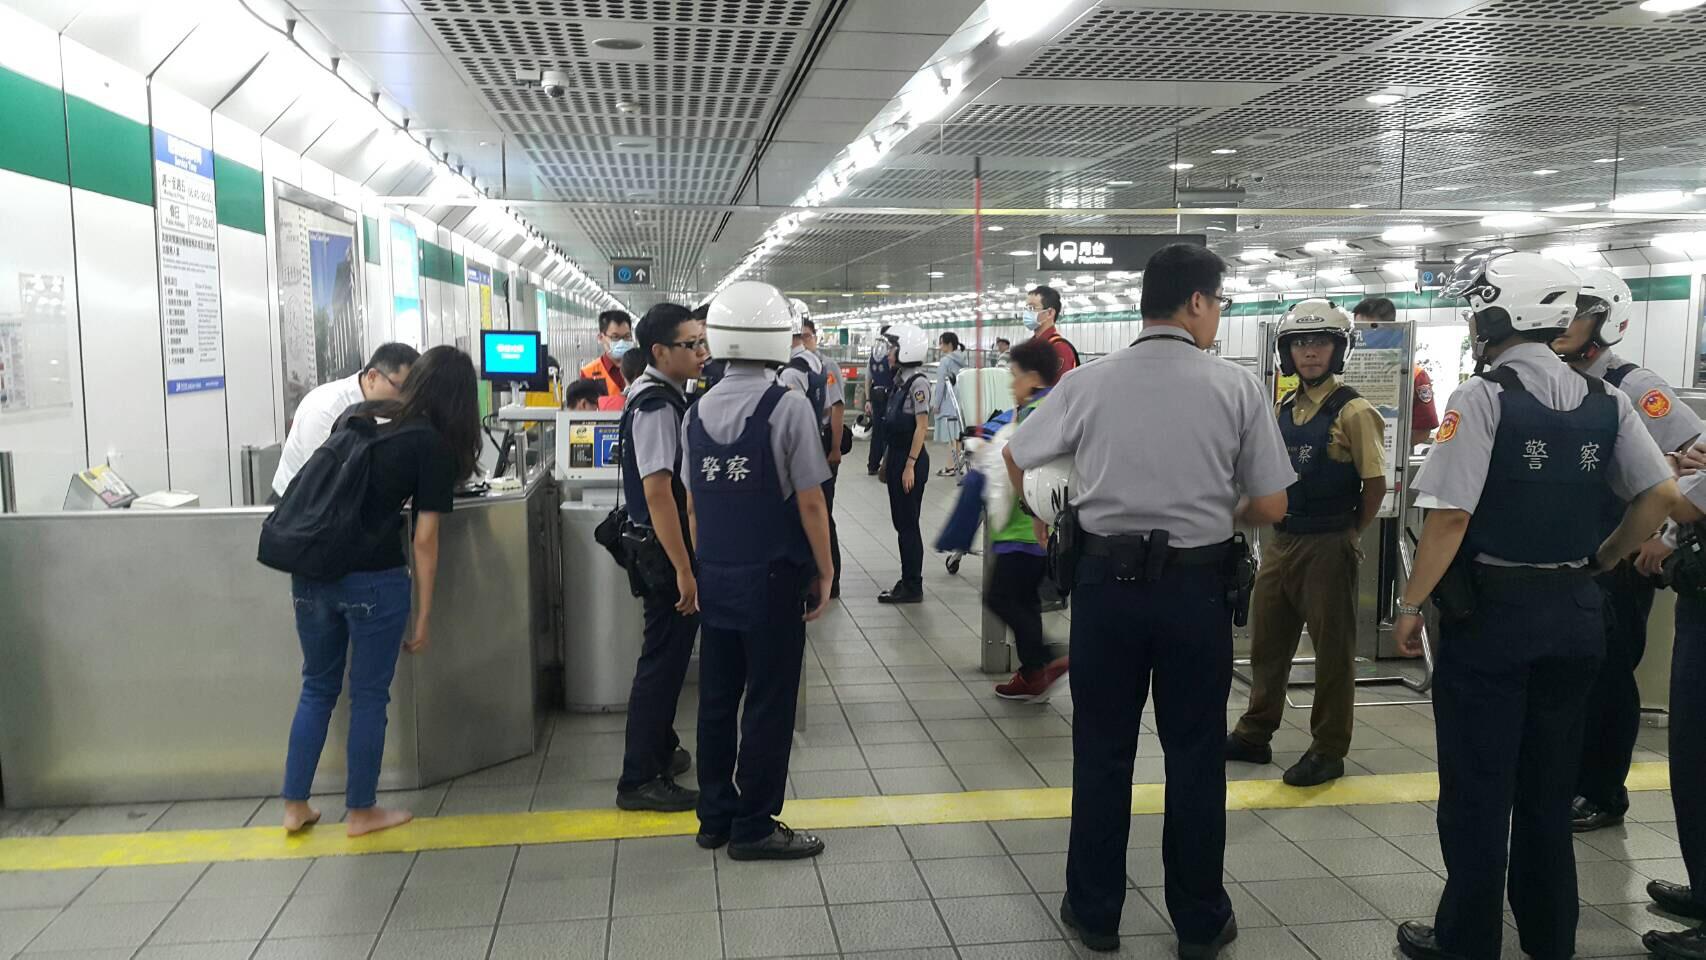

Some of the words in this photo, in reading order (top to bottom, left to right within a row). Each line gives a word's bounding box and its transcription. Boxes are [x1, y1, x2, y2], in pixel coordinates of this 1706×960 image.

[1079, 241, 1105, 256] 月台
[701, 455, 751, 482] 警察
[1522, 439, 1601, 472] 警察
